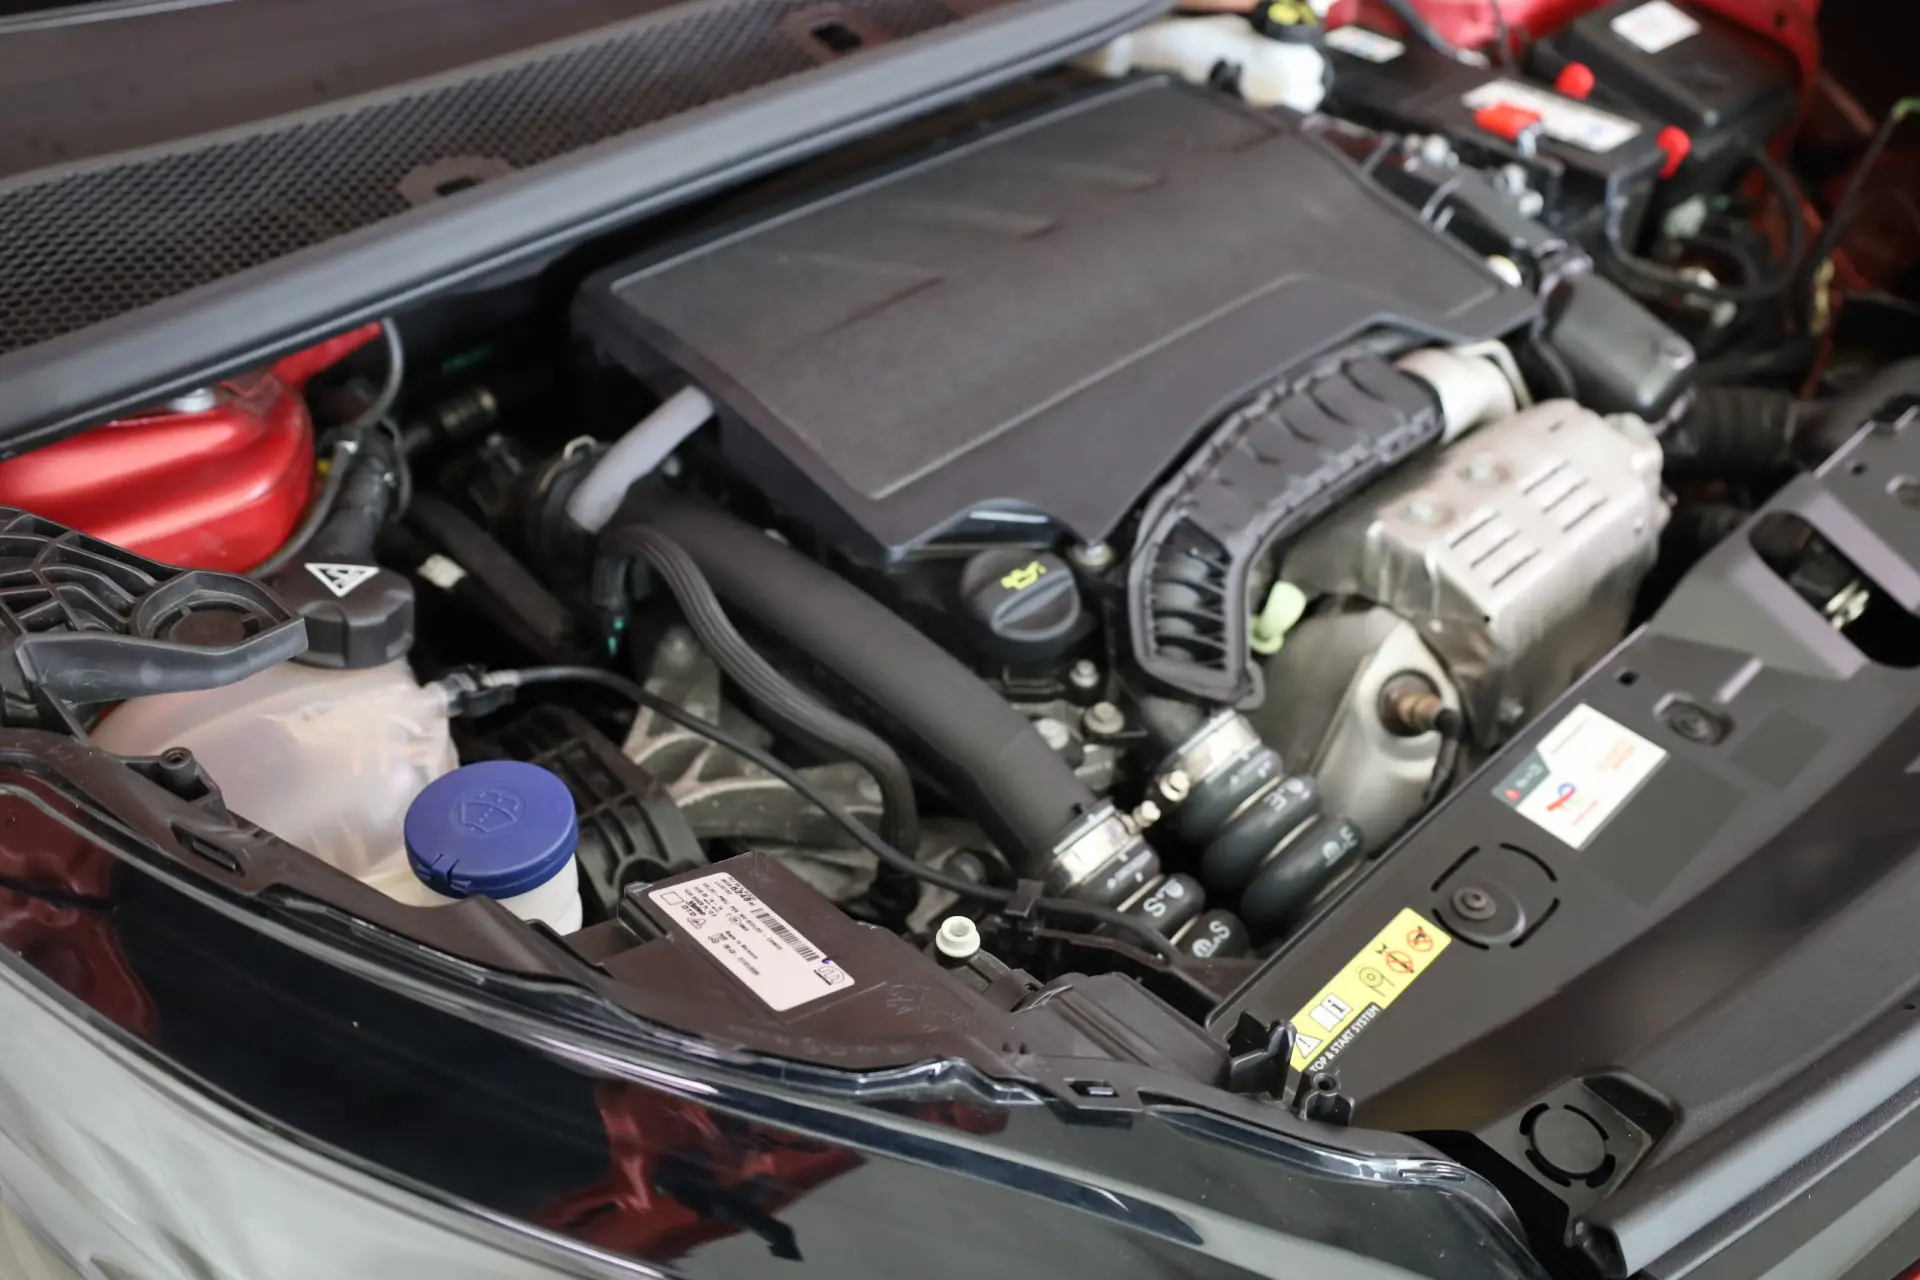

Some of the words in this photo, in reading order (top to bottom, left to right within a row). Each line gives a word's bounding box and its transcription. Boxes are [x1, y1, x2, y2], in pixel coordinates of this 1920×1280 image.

[1308, 1055, 1327, 1072] TOP
[1325, 1051, 1335, 1060] &
[1330, 1029, 1355, 1054] START
[1350, 1004, 1380, 1033] SYSTEM
